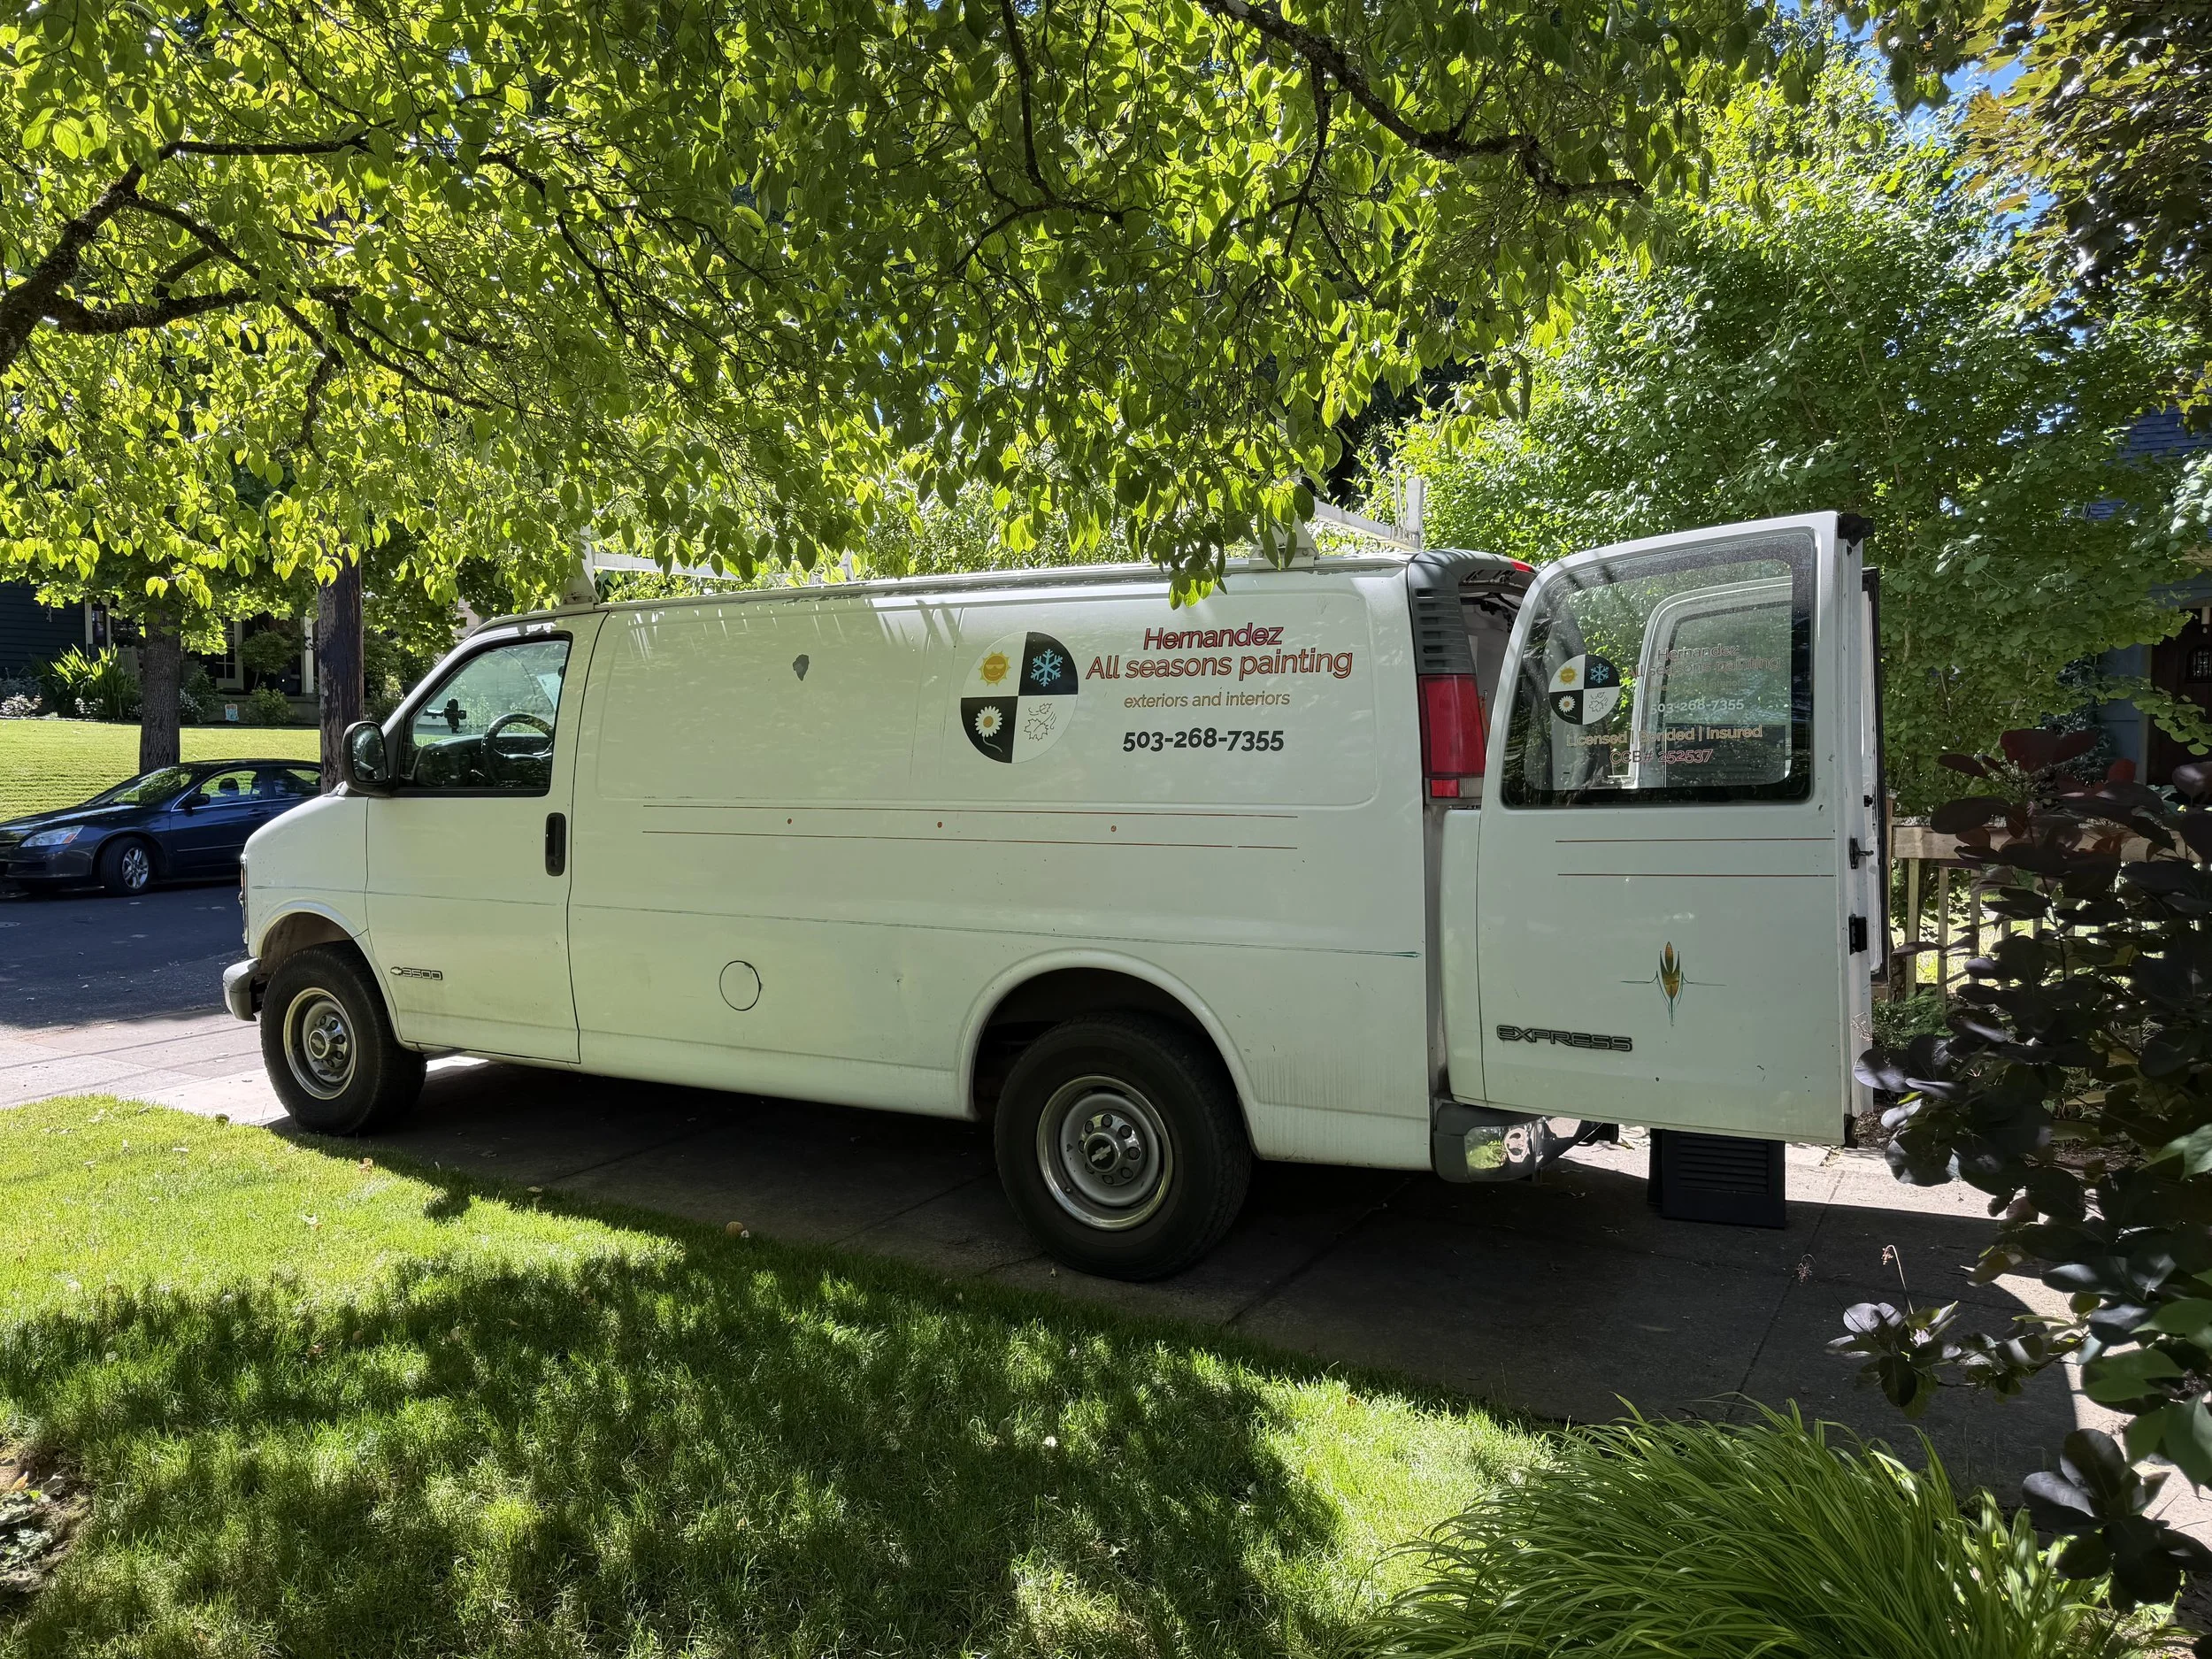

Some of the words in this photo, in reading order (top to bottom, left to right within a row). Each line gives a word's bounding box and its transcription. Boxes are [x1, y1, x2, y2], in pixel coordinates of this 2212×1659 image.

[1143, 623, 1284, 650] Hernandez
[1657, 643, 1740, 661] Hernandez
[1086, 655, 1120, 680] All
[1125, 657, 1232, 679] seasons
[1239, 648, 1353, 681] painting
[1627, 664, 1643, 678] All
[1648, 663, 1711, 677] seasons
[1715, 656, 1782, 673] painting
[1124, 694, 1188, 708] exteriors
[1192, 692, 1221, 707] and
[1225, 690, 1290, 706] interiors
[1650, 699, 1745, 715] 503-268-7355
[1123, 727, 1284, 752] 503-268-7355
[1566, 731, 1628, 747] Licensed
[1640, 726, 1695, 743] Bonded
[1706, 725, 1763, 740] Insured
[1609, 749, 1654, 764] CCB#
[1657, 749, 1714, 763] 252537
[402, 967, 443, 980] 3500
[1496, 1025, 1633, 1052] EXPRESS
